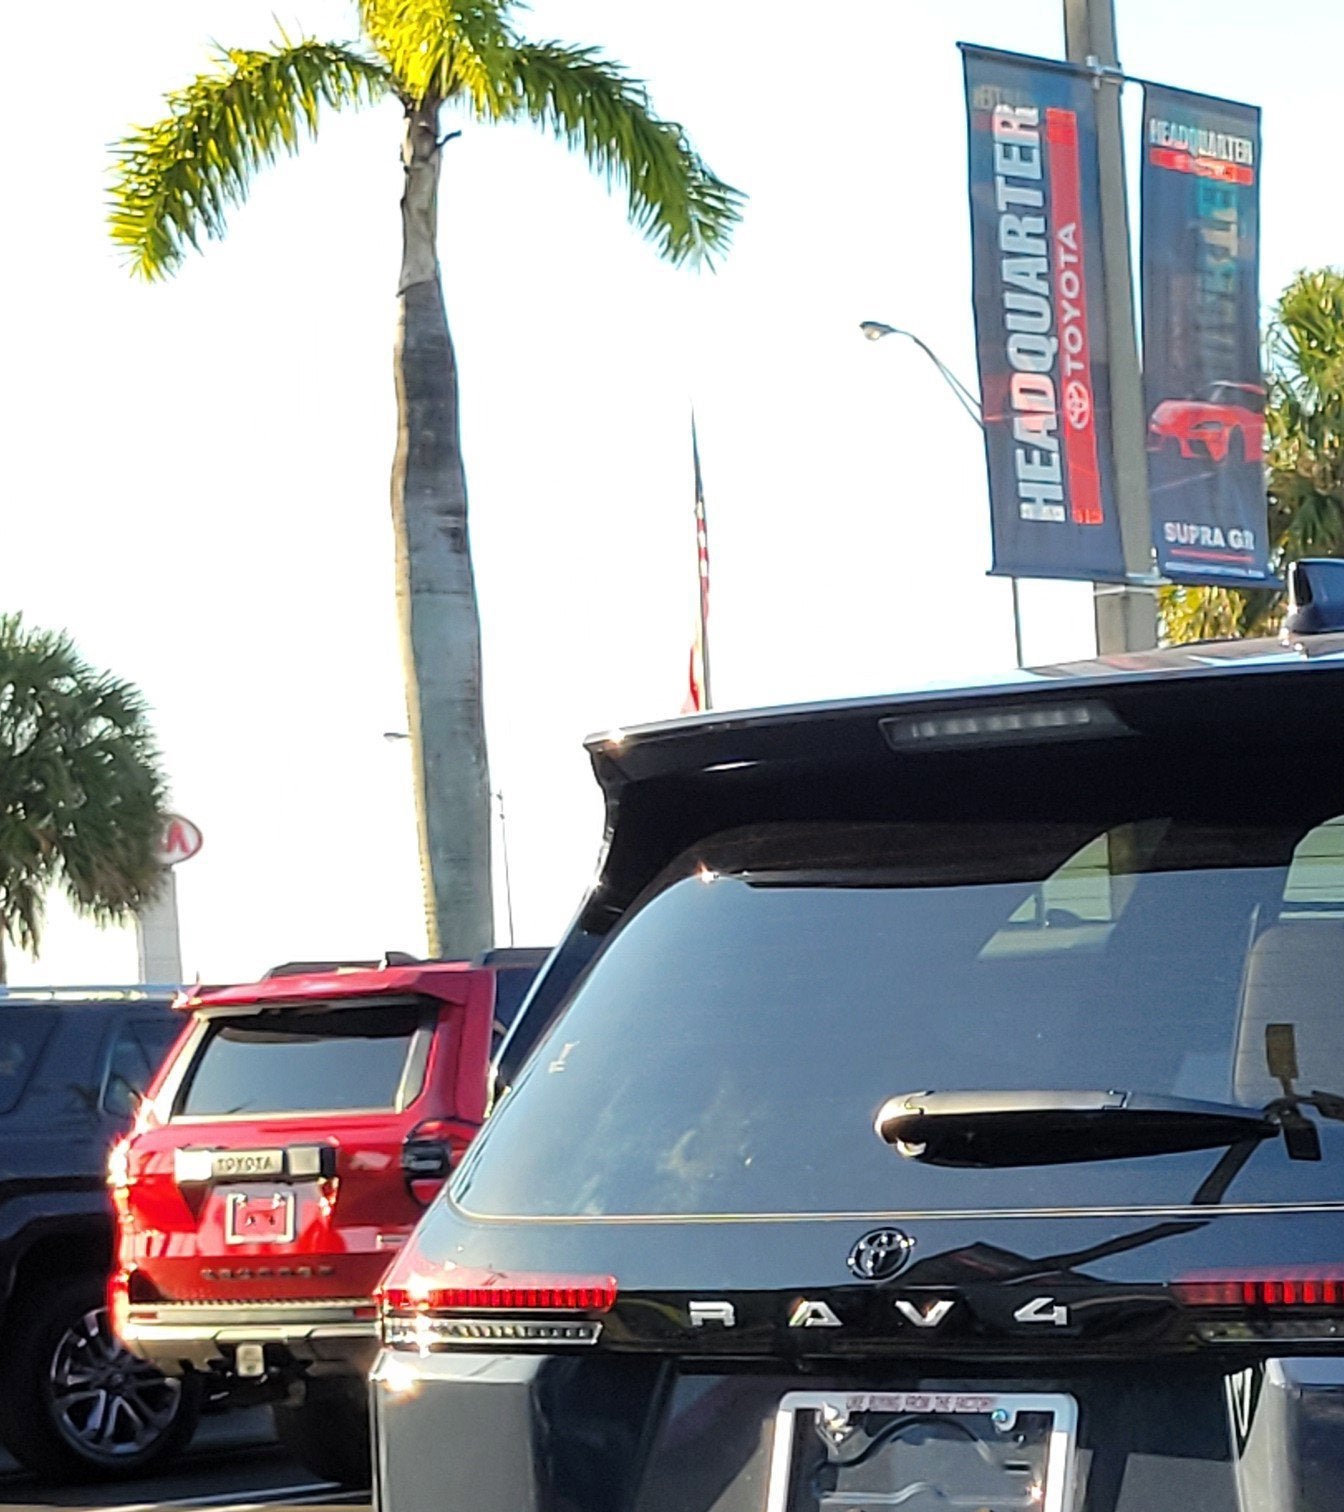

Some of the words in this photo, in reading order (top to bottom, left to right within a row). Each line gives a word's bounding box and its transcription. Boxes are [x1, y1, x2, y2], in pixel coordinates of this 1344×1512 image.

[992, 104, 1065, 522] HEADQUARTER
[1058, 222, 1080, 377] TOYOTA
[1164, 521, 1226, 548] SUPRA
[216, 1156, 274, 1170] TOYOTA
[688, 1297, 1069, 1328] RAV4
